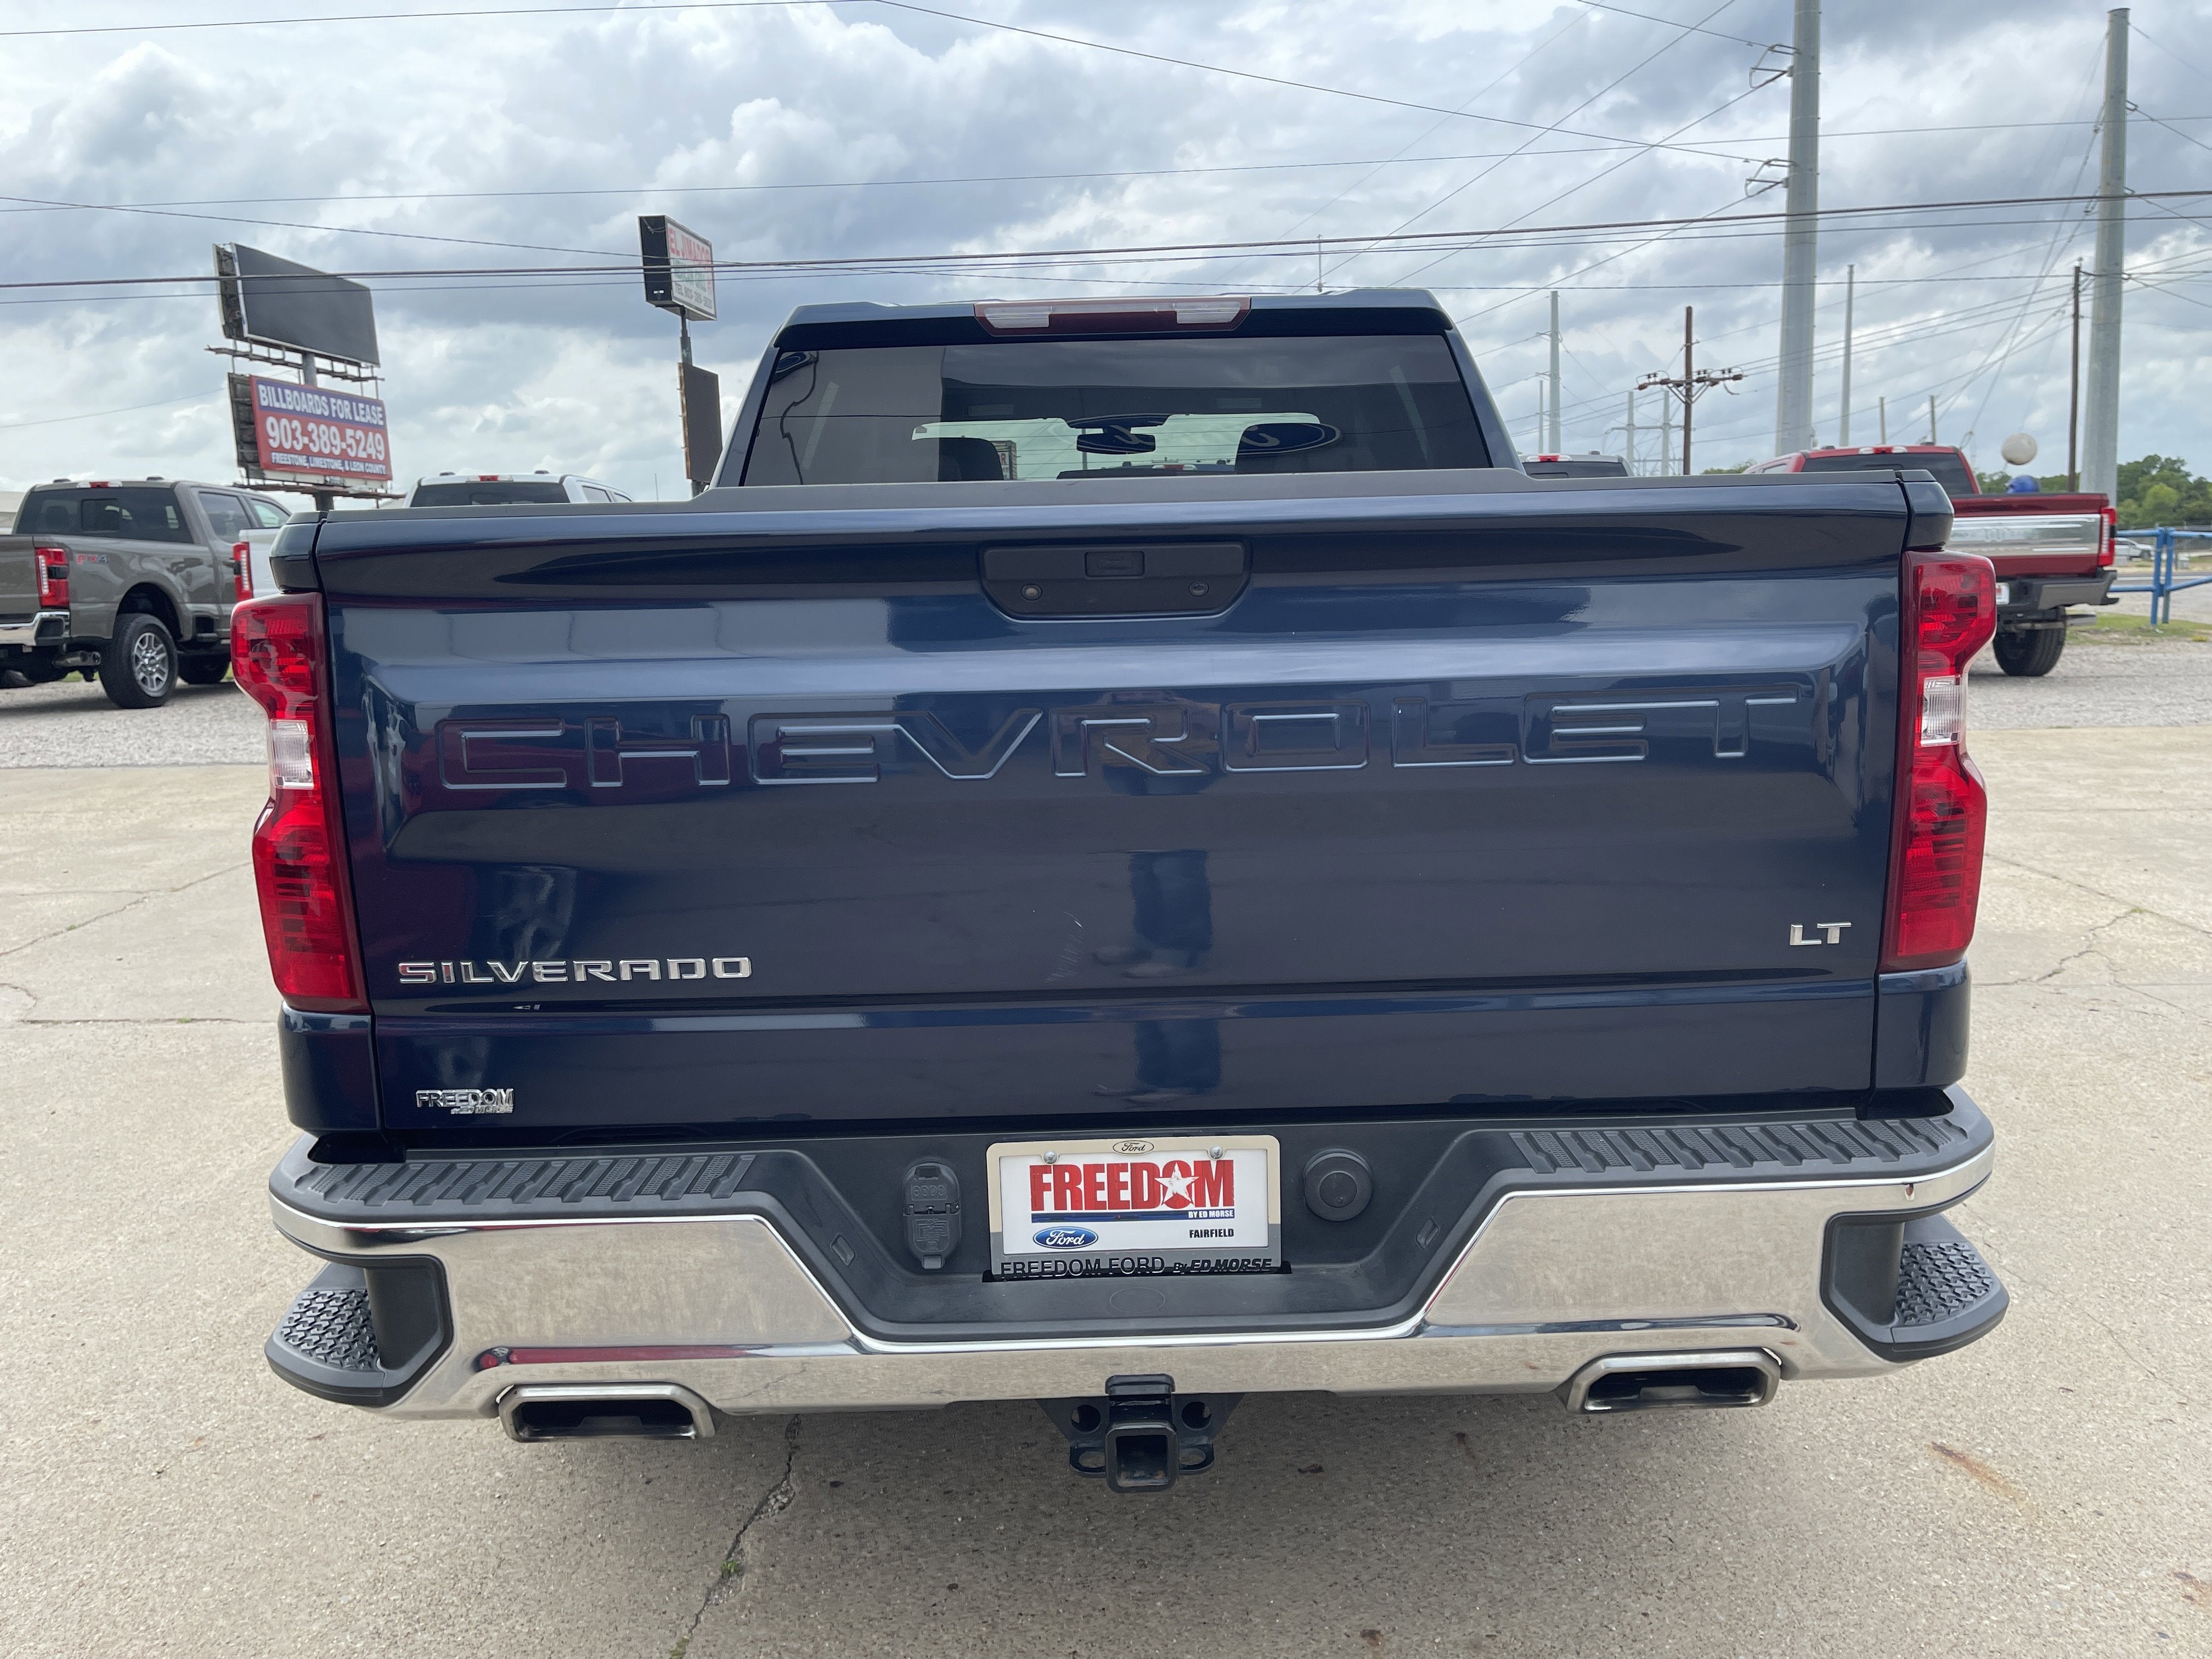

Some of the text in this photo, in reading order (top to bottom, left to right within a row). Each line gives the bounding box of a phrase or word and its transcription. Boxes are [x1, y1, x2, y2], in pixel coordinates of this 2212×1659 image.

[669, 228, 680, 256] EL
[258, 384, 384, 426] BILLBOARDS FOR LEASE
[266, 416, 385, 461] 903-389-5249
[436, 684, 1801, 791] CHEVROLET
[1790, 922, 1852, 946] LT
[398, 956, 753, 983] SILVERADO
[416, 1088, 514, 1108] FREEDOM
[1121, 1142, 1146, 1152] Ford
[1030, 1160, 1234, 1211] FREEDOM
[1046, 1229, 1085, 1245] Ford
[1189, 1228, 1234, 1238] FAIRFIELD
[1001, 1259, 1101, 1279] FREEDOM
[1109, 1256, 1164, 1275] FORD
[1190, 1260, 1211, 1272] ED
[1214, 1259, 1272, 1272] MORSE
